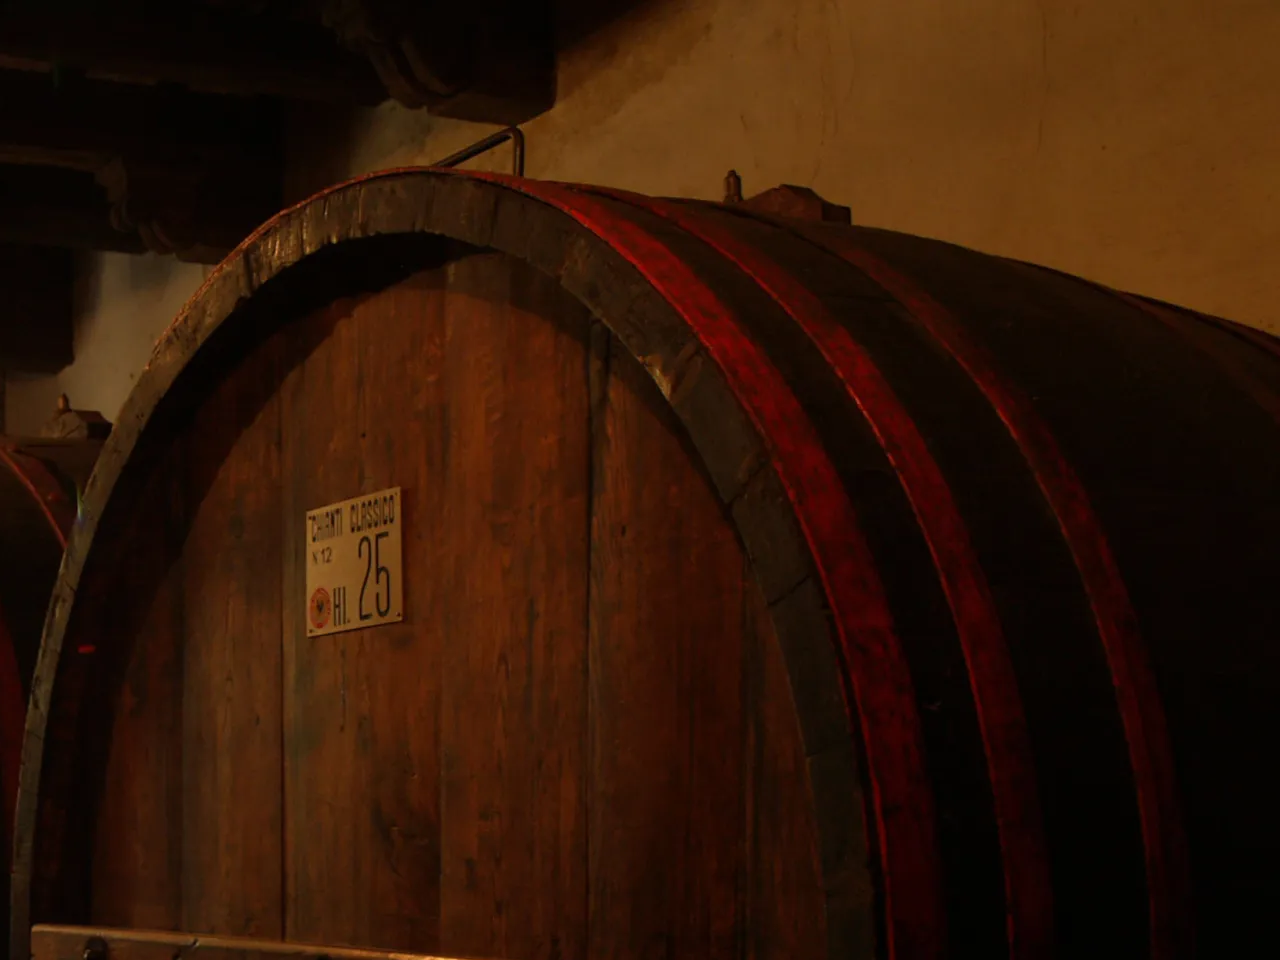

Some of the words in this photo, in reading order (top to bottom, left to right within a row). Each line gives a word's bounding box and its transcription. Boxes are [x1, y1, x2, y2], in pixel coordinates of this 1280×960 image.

[312, 507, 343, 543] CHIANTI
[350, 494, 395, 533] CLASSICO
[358, 531, 390, 620] 25
